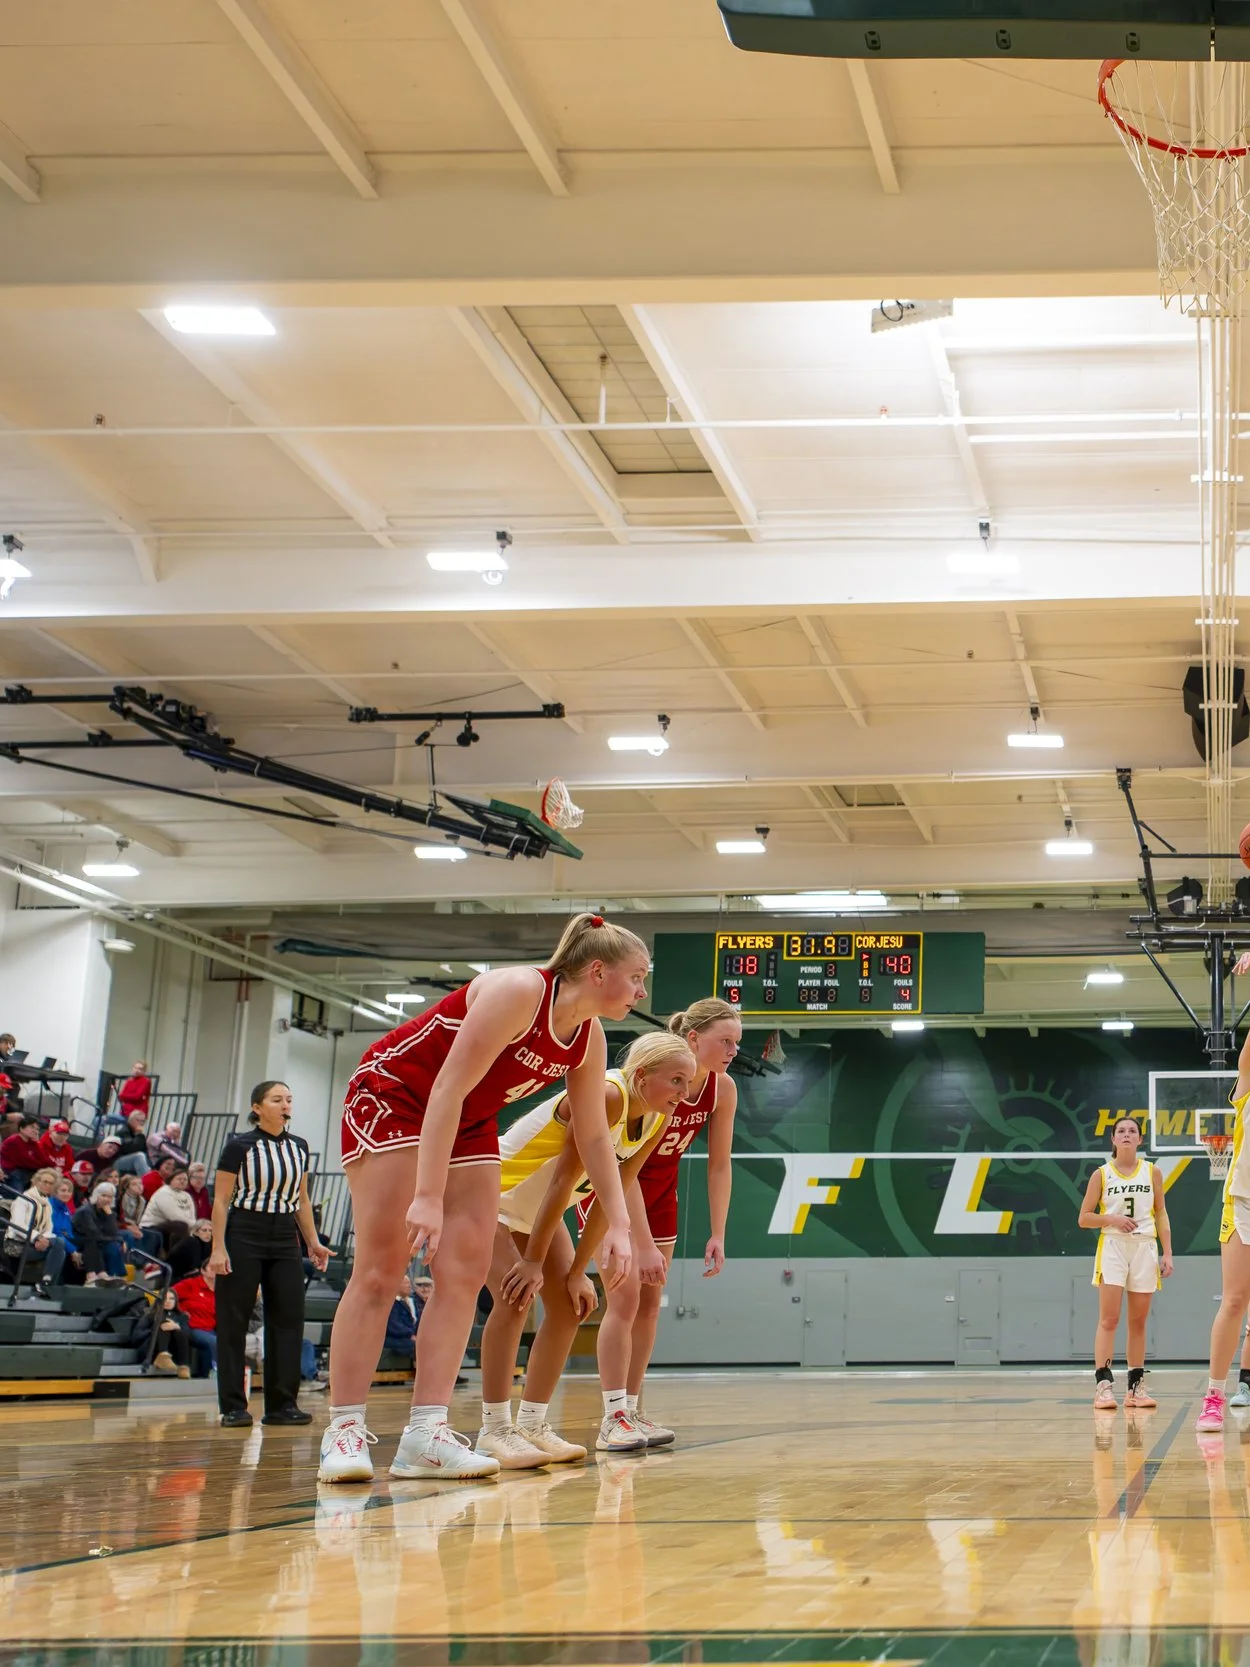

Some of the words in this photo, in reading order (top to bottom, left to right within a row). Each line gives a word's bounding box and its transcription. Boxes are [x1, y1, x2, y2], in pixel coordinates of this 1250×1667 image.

[719, 936, 774, 949] FLYERS
[886, 956, 911, 974] 40
[514, 1046, 544, 1073] COR
[658, 1130, 695, 1155] 24
[1107, 1185, 1150, 1196] FLYERS
[1124, 1197, 1134, 1218] 3
